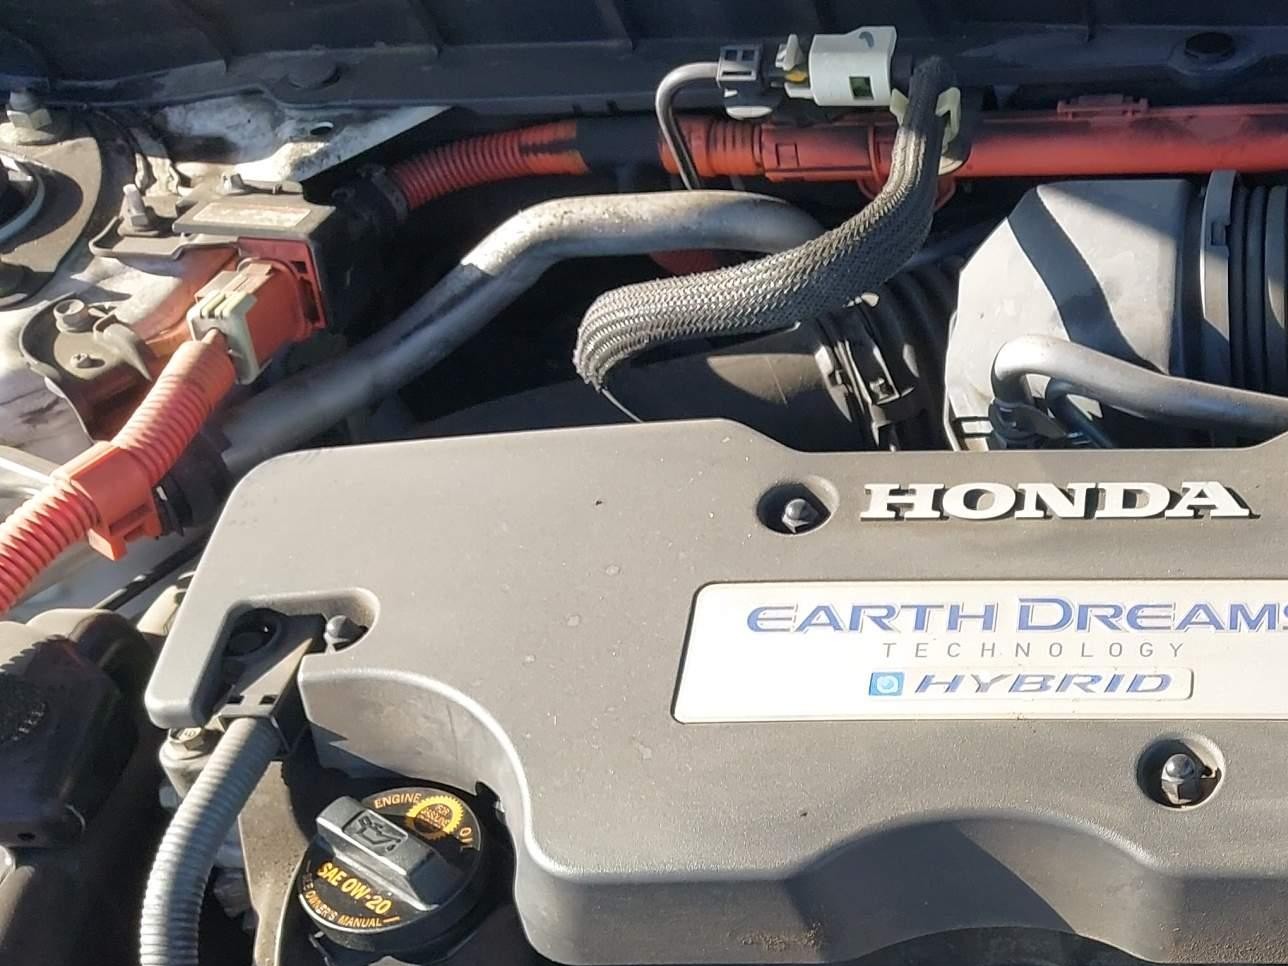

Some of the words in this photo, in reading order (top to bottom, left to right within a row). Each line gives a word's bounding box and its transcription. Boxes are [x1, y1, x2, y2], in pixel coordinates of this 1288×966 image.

[860, 482, 1254, 519] HONDA
[747, 603, 997, 633] EARTH
[882, 642, 1186, 659] TECHNOLOGY
[914, 673, 1173, 695] HYBRID
[374, 793, 422, 809] ENGINE
[317, 862, 343, 887] SAE
[337, 914, 383, 928] MANUAL
